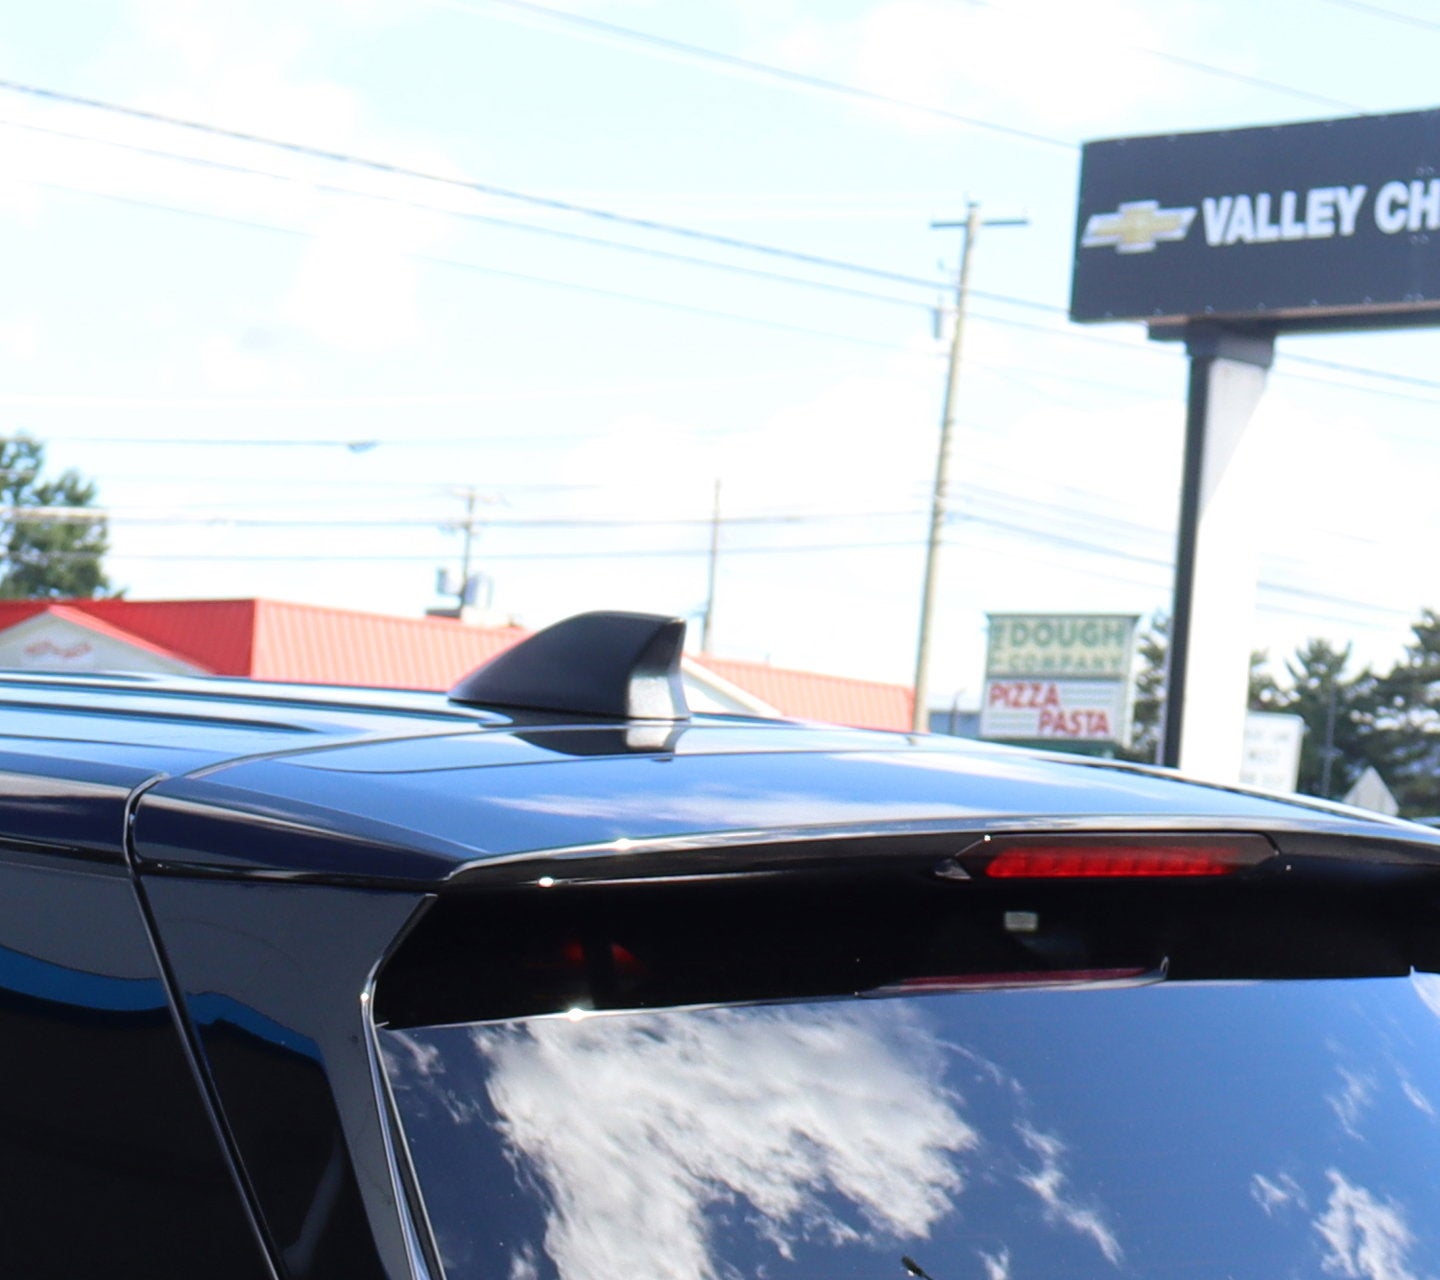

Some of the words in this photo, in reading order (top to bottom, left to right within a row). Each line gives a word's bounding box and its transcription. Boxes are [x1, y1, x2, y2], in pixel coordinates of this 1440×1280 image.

[1202, 185, 1367, 247] VALLEY
[1011, 622, 1124, 647] DOUGH
[989, 682, 1060, 708] PIZZA
[1039, 710, 1110, 736] PASTA
